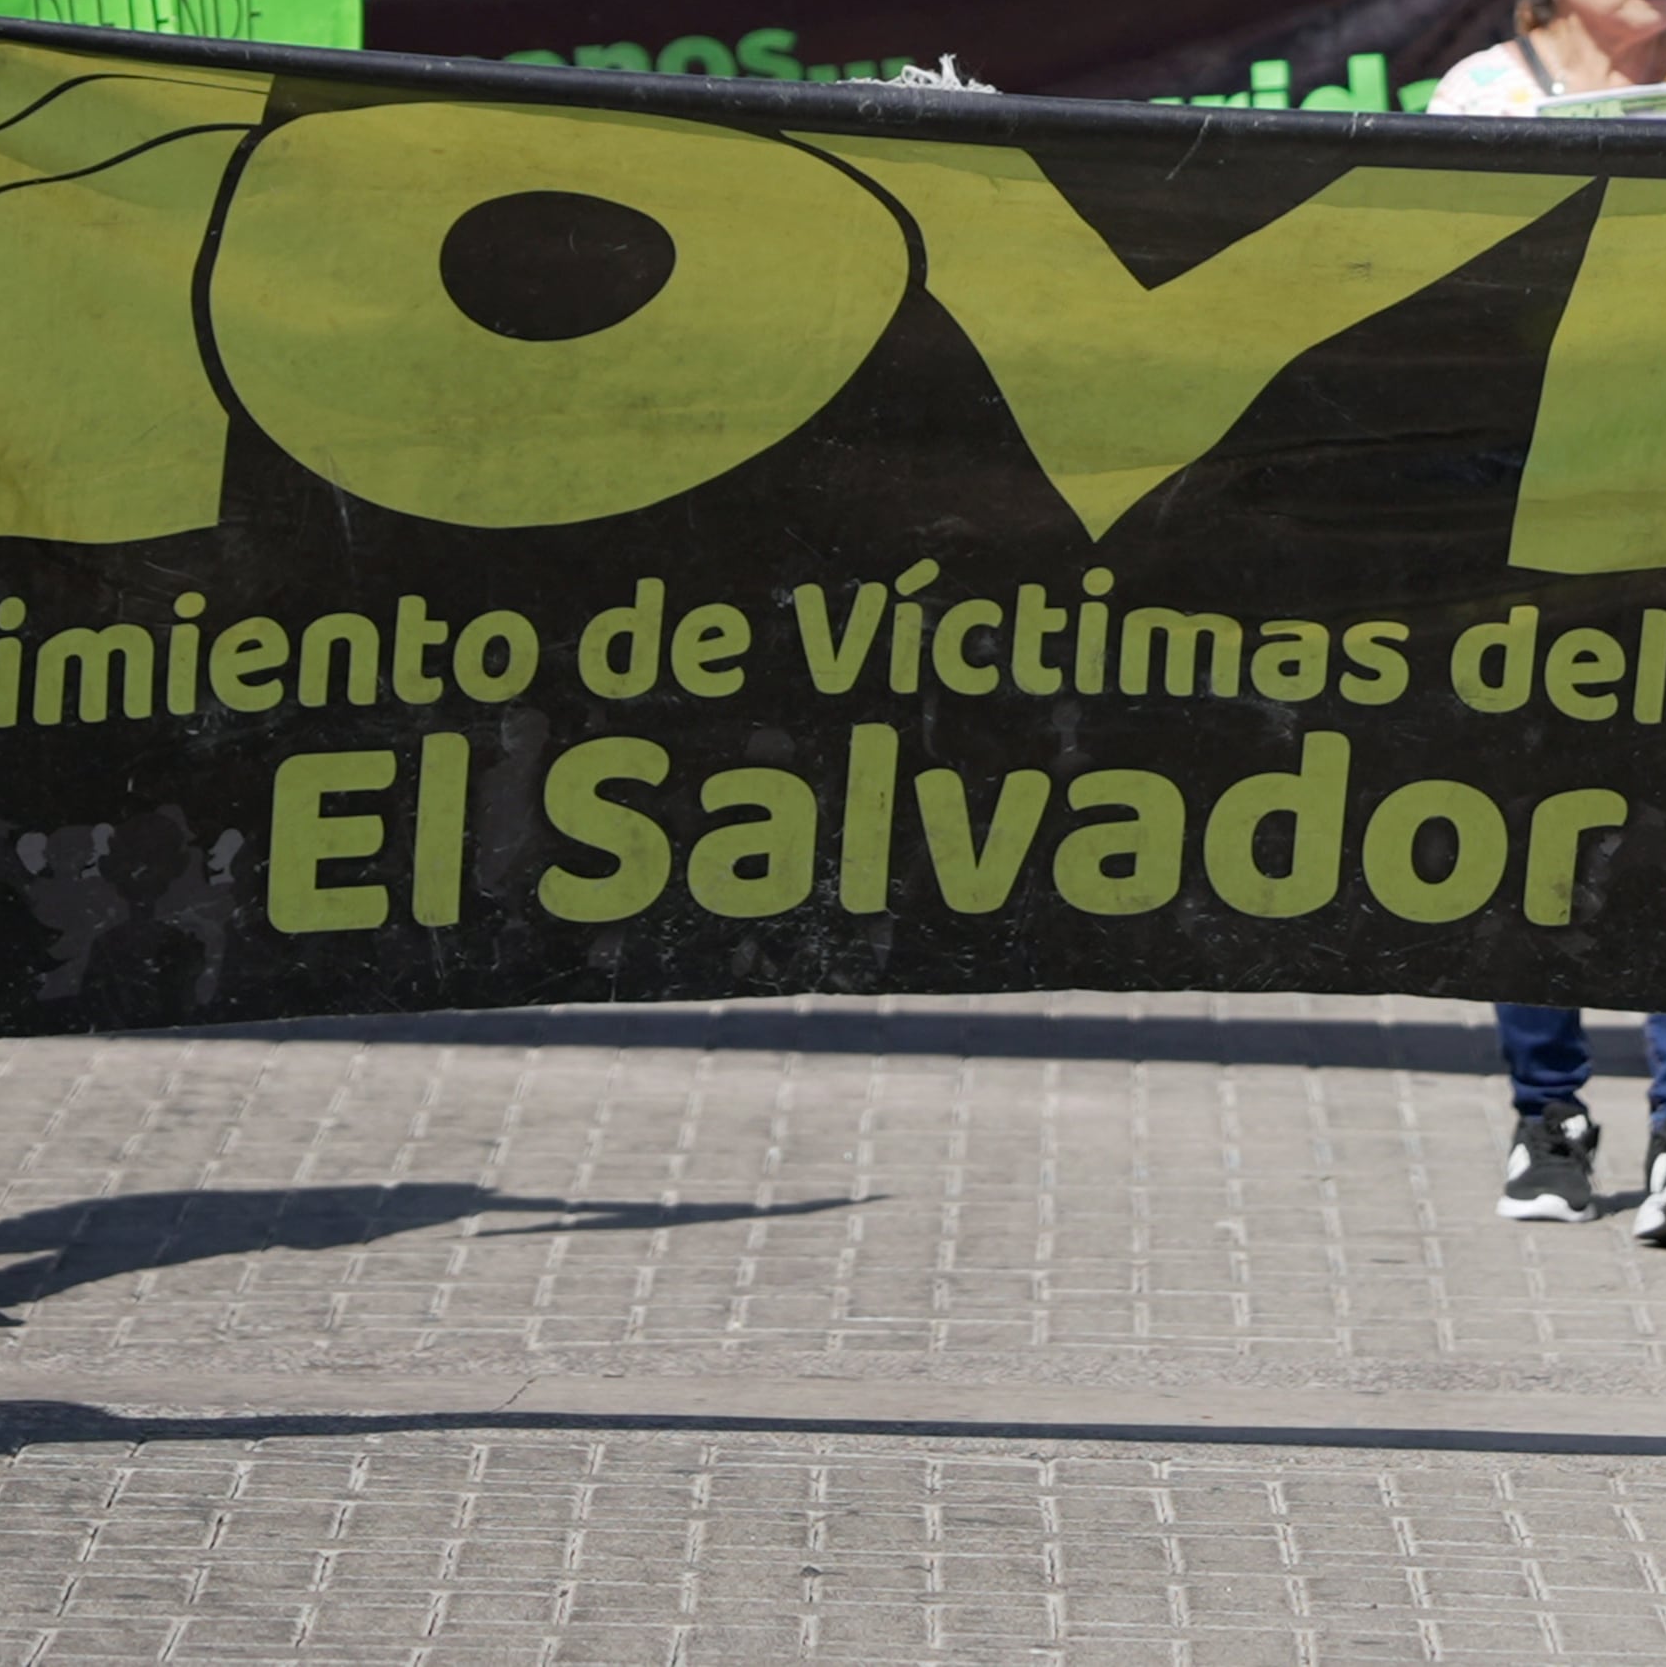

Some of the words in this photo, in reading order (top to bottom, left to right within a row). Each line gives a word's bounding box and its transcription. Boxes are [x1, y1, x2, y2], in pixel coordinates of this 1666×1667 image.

[578, 577, 751, 699] de
[794, 558, 1410, 705] Víctimas
[268, 732, 470, 933] El
[539, 723, 1628, 927] Salvador
